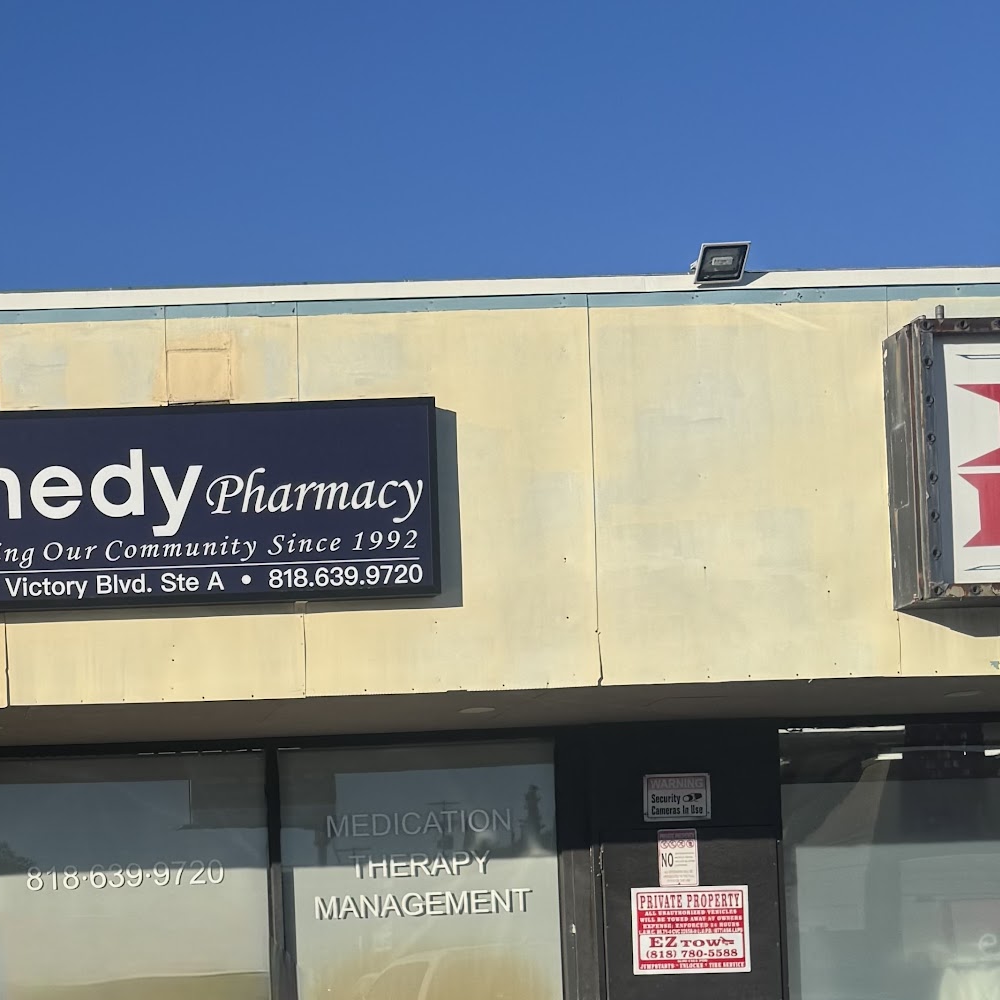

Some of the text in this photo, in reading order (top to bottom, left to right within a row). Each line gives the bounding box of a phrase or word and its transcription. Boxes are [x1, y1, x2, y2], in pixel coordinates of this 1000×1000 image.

[205, 467, 424, 524] Pharmacy
[43, 541, 98, 562] Our
[105, 535, 257, 562] Community
[268, 532, 342, 555] Since
[352, 529, 419, 552] 1992
[5, 576, 88, 600] Victory
[97, 573, 153, 596] Blvd.
[161, 572, 200, 593] Ste
[206, 571, 225, 591] A
[268, 563, 423, 589] 818.639.9720
[650, 777, 704, 789] WARNING
[651, 793, 680, 804] Security
[651, 804, 703, 815] Cameras In Use
[326, 808, 511, 838] MEDICATION
[348, 850, 491, 879] THERAPY
[661, 852, 674, 867] NO
[314, 887, 533, 920] MANAGEMENT
[640, 893, 740, 909] PRIVATE PROPERTY
[649, 936, 721, 948] EZ TOW
[646, 948, 738, 959] (818) 780-5588
